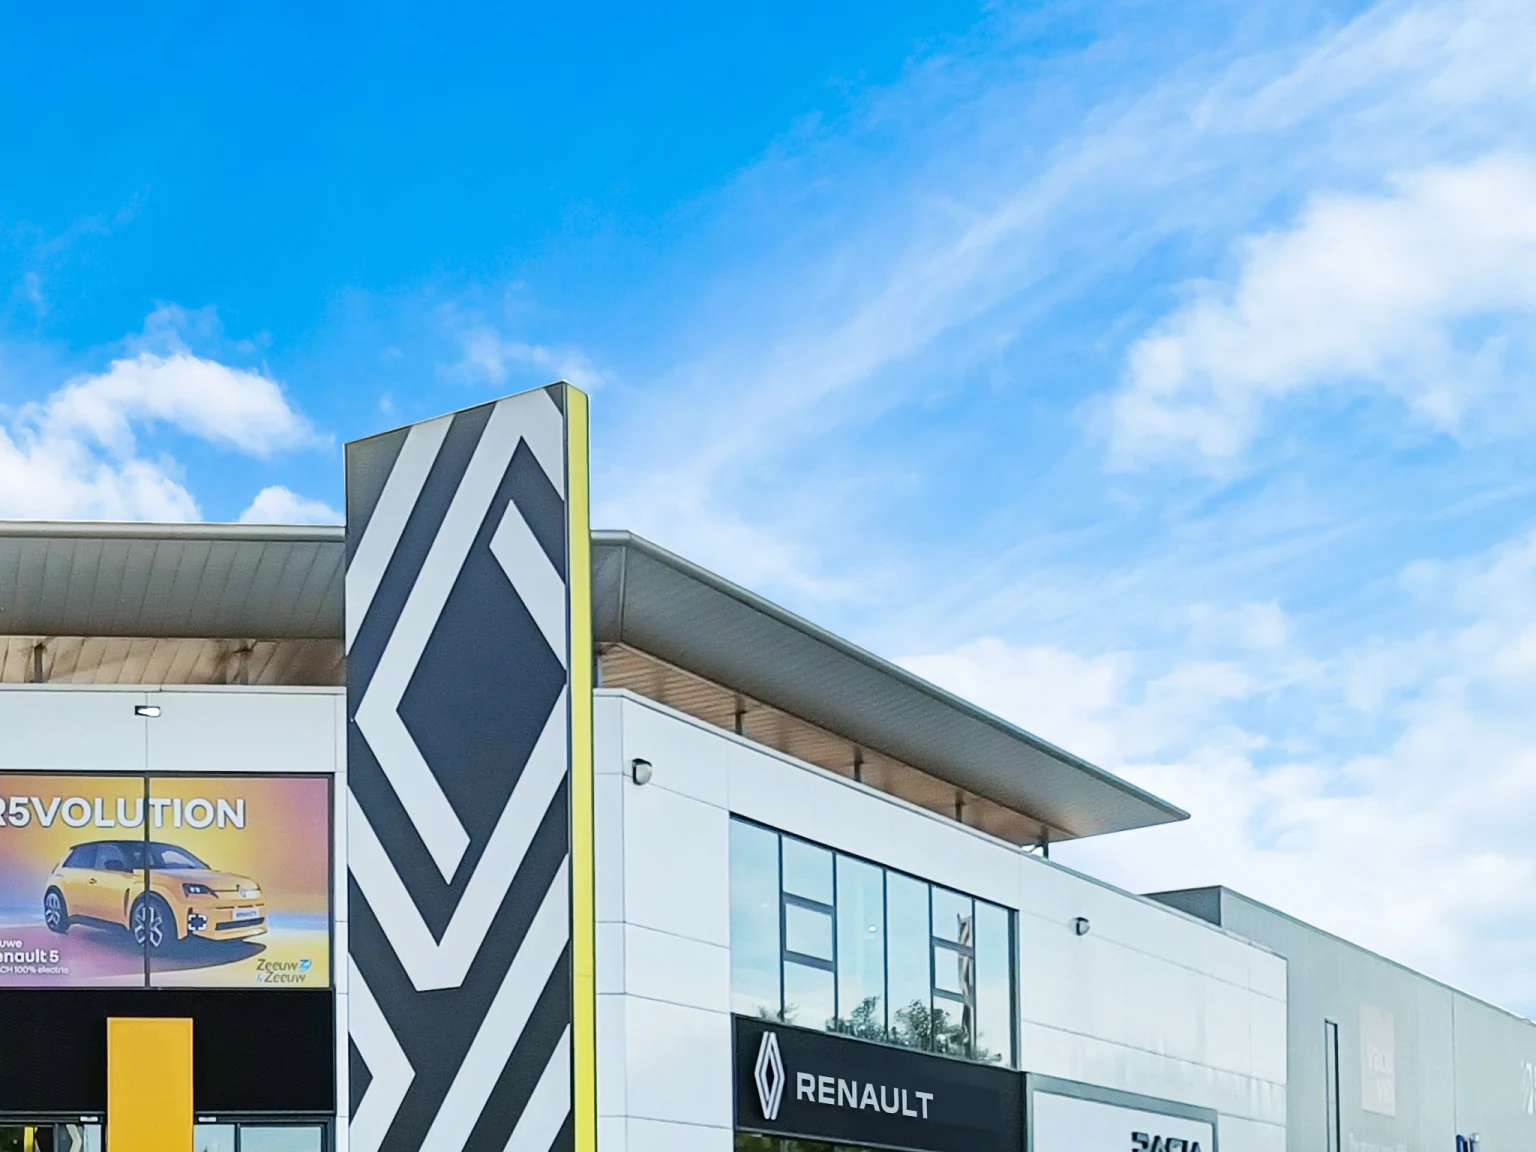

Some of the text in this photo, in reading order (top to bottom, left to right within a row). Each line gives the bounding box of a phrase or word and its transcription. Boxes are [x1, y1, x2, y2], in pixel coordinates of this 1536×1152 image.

[50, 950, 59, 963] 5
[14, 966, 36, 974] 100%
[256, 959, 298, 971] Zeeuw
[264, 971, 306, 983] Zeeuw
[796, 1072, 934, 1119] RENAULT
